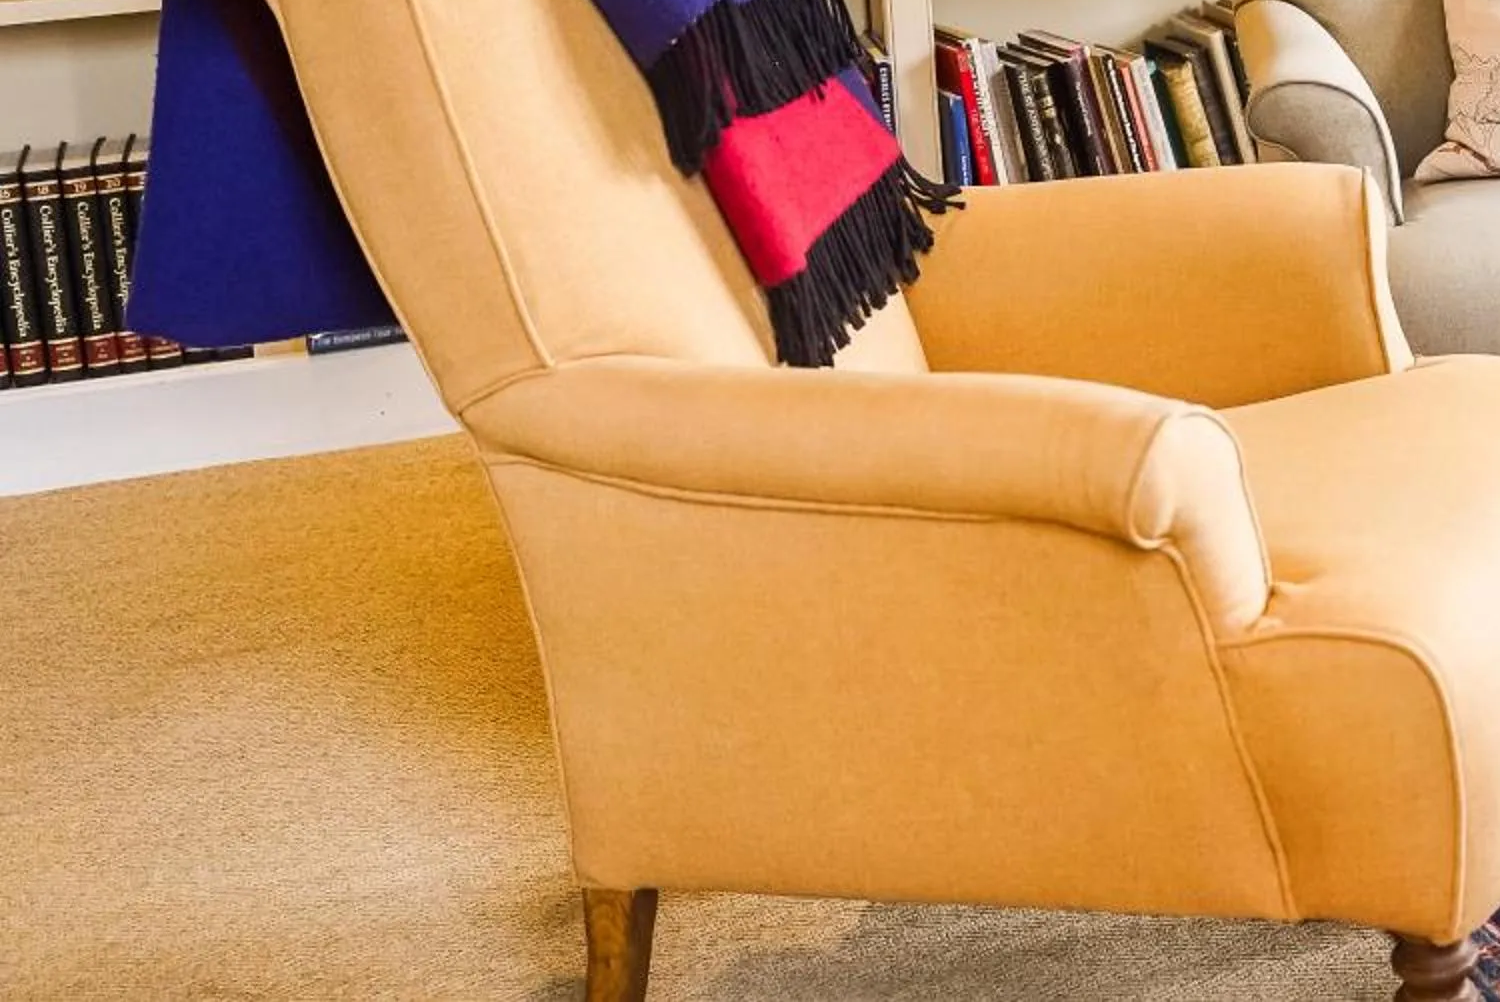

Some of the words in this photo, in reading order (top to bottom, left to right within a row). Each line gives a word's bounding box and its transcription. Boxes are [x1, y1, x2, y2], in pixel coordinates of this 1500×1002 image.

[1, 209, 18, 256] Collier's
[39, 205, 57, 253] Collier's
[76, 201, 92, 250] Collier's
[109, 197, 126, 246] Collier's
[8, 260, 31, 337] Encyclopedia
[45, 256, 67, 333] Encyclopedia
[82, 252, 105, 330] Encyclopedia
